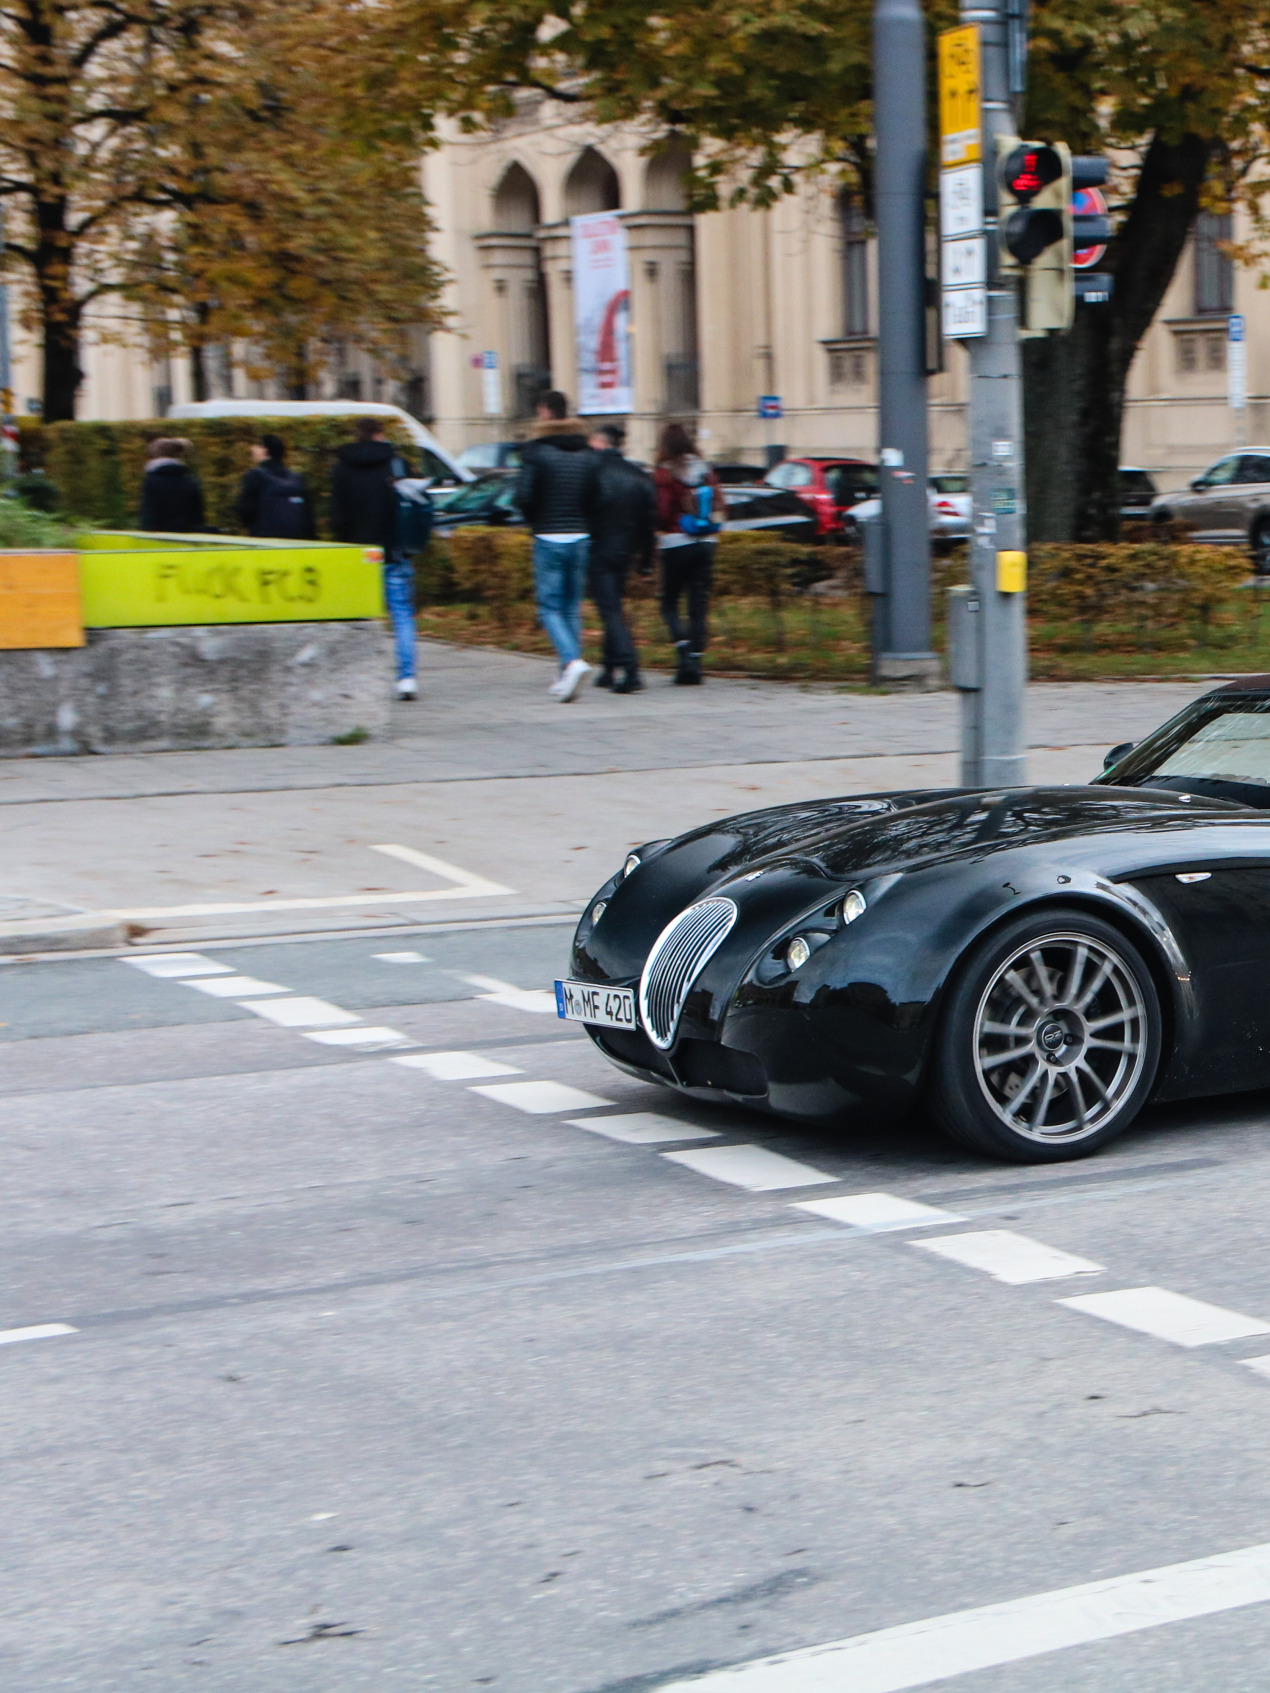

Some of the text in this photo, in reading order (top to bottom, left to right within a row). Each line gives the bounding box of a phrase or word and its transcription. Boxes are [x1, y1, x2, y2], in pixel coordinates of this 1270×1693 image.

[564, 987, 632, 1023] M MF 420
